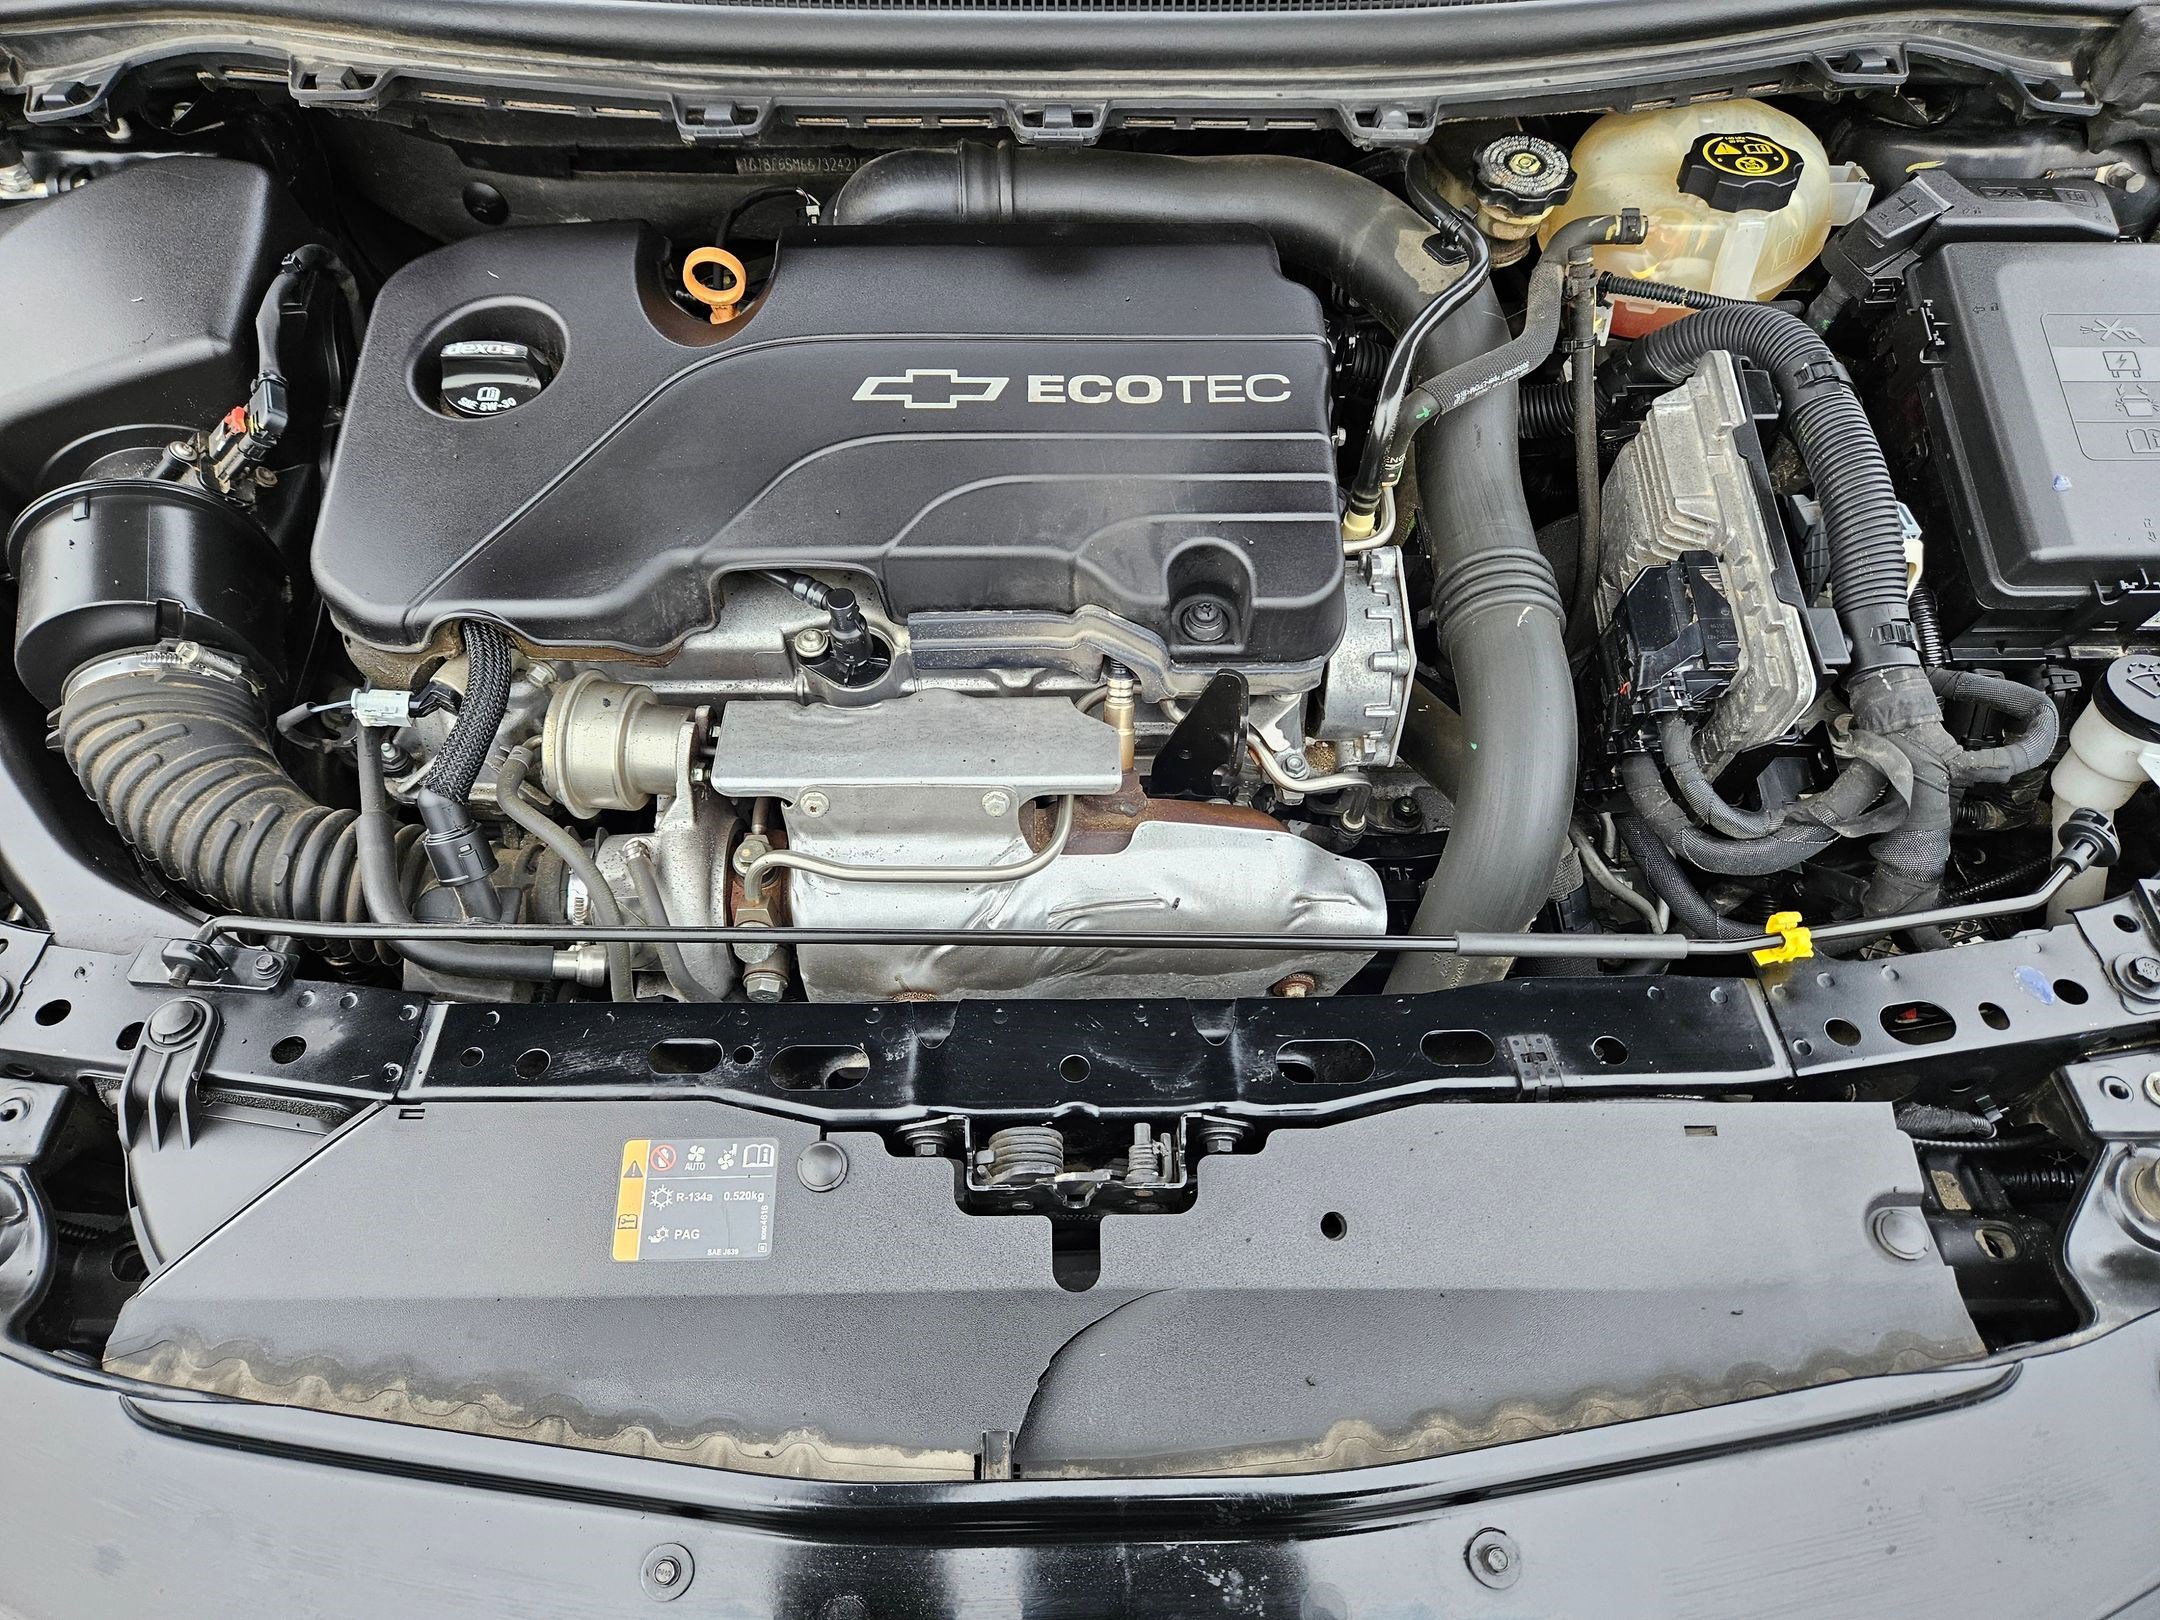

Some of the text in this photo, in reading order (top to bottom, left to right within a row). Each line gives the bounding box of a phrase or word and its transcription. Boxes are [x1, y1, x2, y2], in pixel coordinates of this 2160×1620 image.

[446, 343, 516, 355] dexos
[1027, 374, 1292, 404] ECOTEC
[479, 397, 517, 411] 5W-30
[684, 1162, 706, 1171] AUTO
[676, 1191, 765, 1202] R-134a 0.520kg
[674, 1229, 700, 1240] PAG
[707, 1248, 722, 1256] SAE
